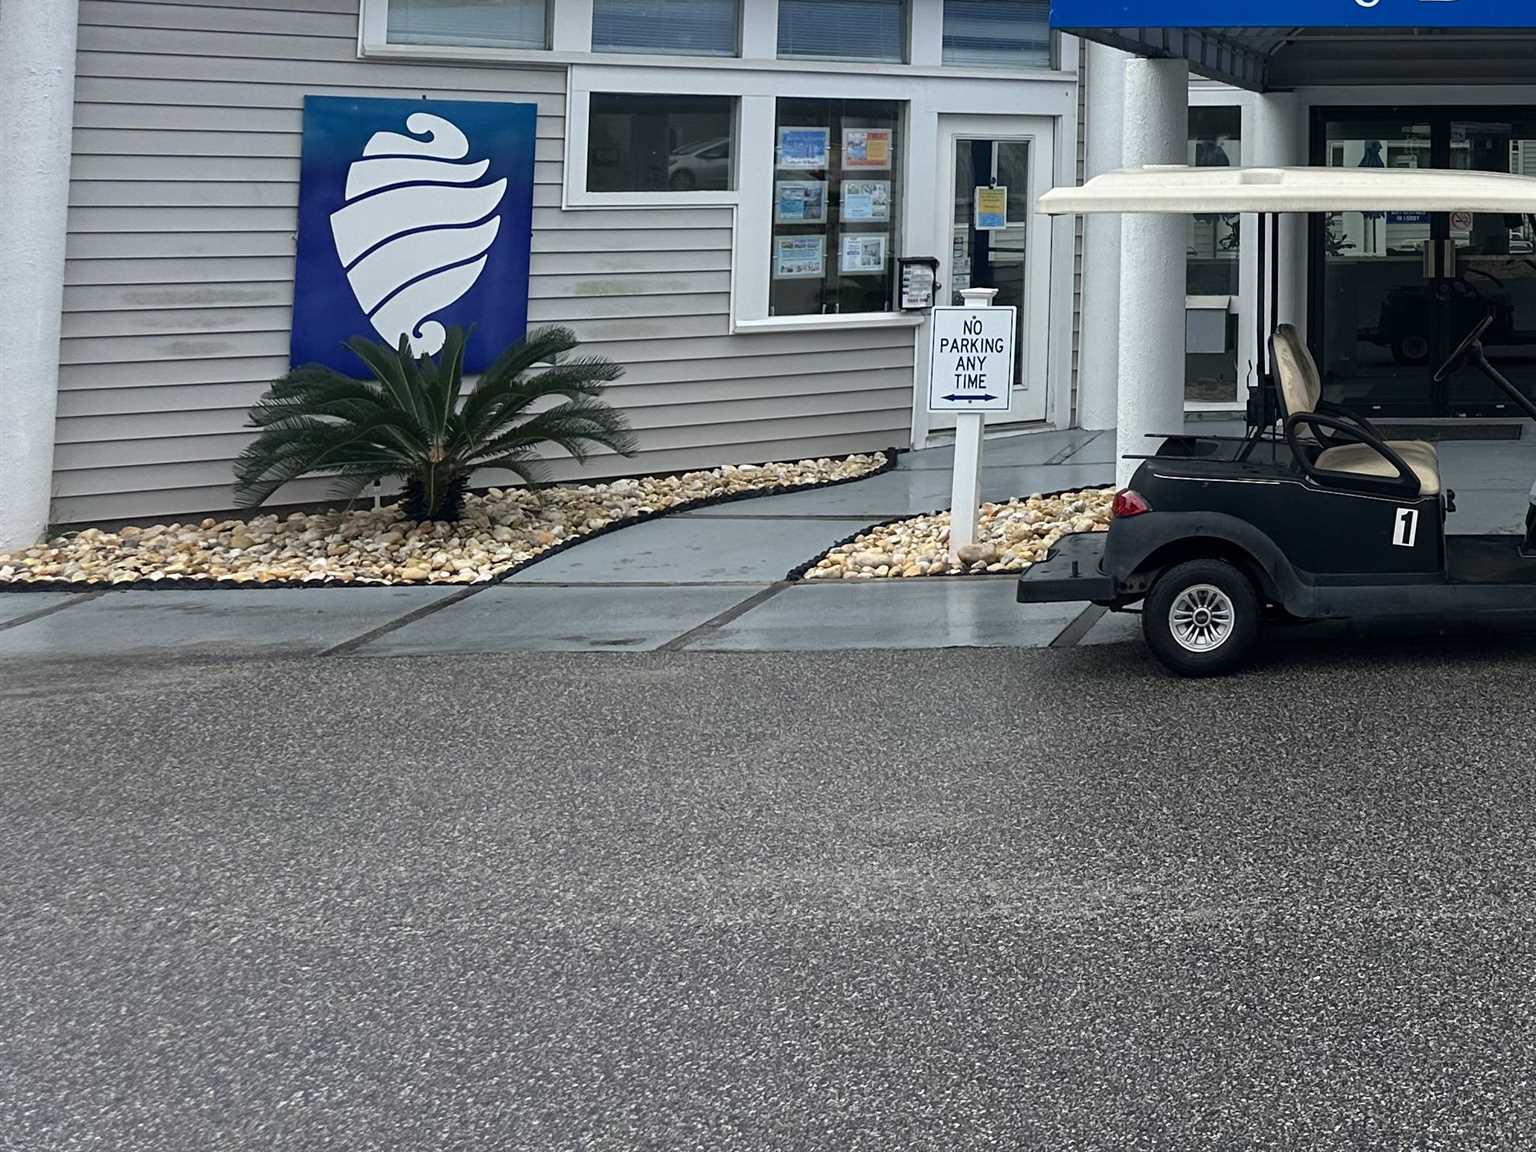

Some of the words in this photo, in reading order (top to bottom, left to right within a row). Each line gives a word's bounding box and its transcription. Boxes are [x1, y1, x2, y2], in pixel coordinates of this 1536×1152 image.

[963, 320, 983, 335] NO
[940, 338, 1004, 353] PARKING
[955, 356, 987, 371] ANY
[954, 373, 987, 389] TIME
[1401, 511, 1414, 544] 1
